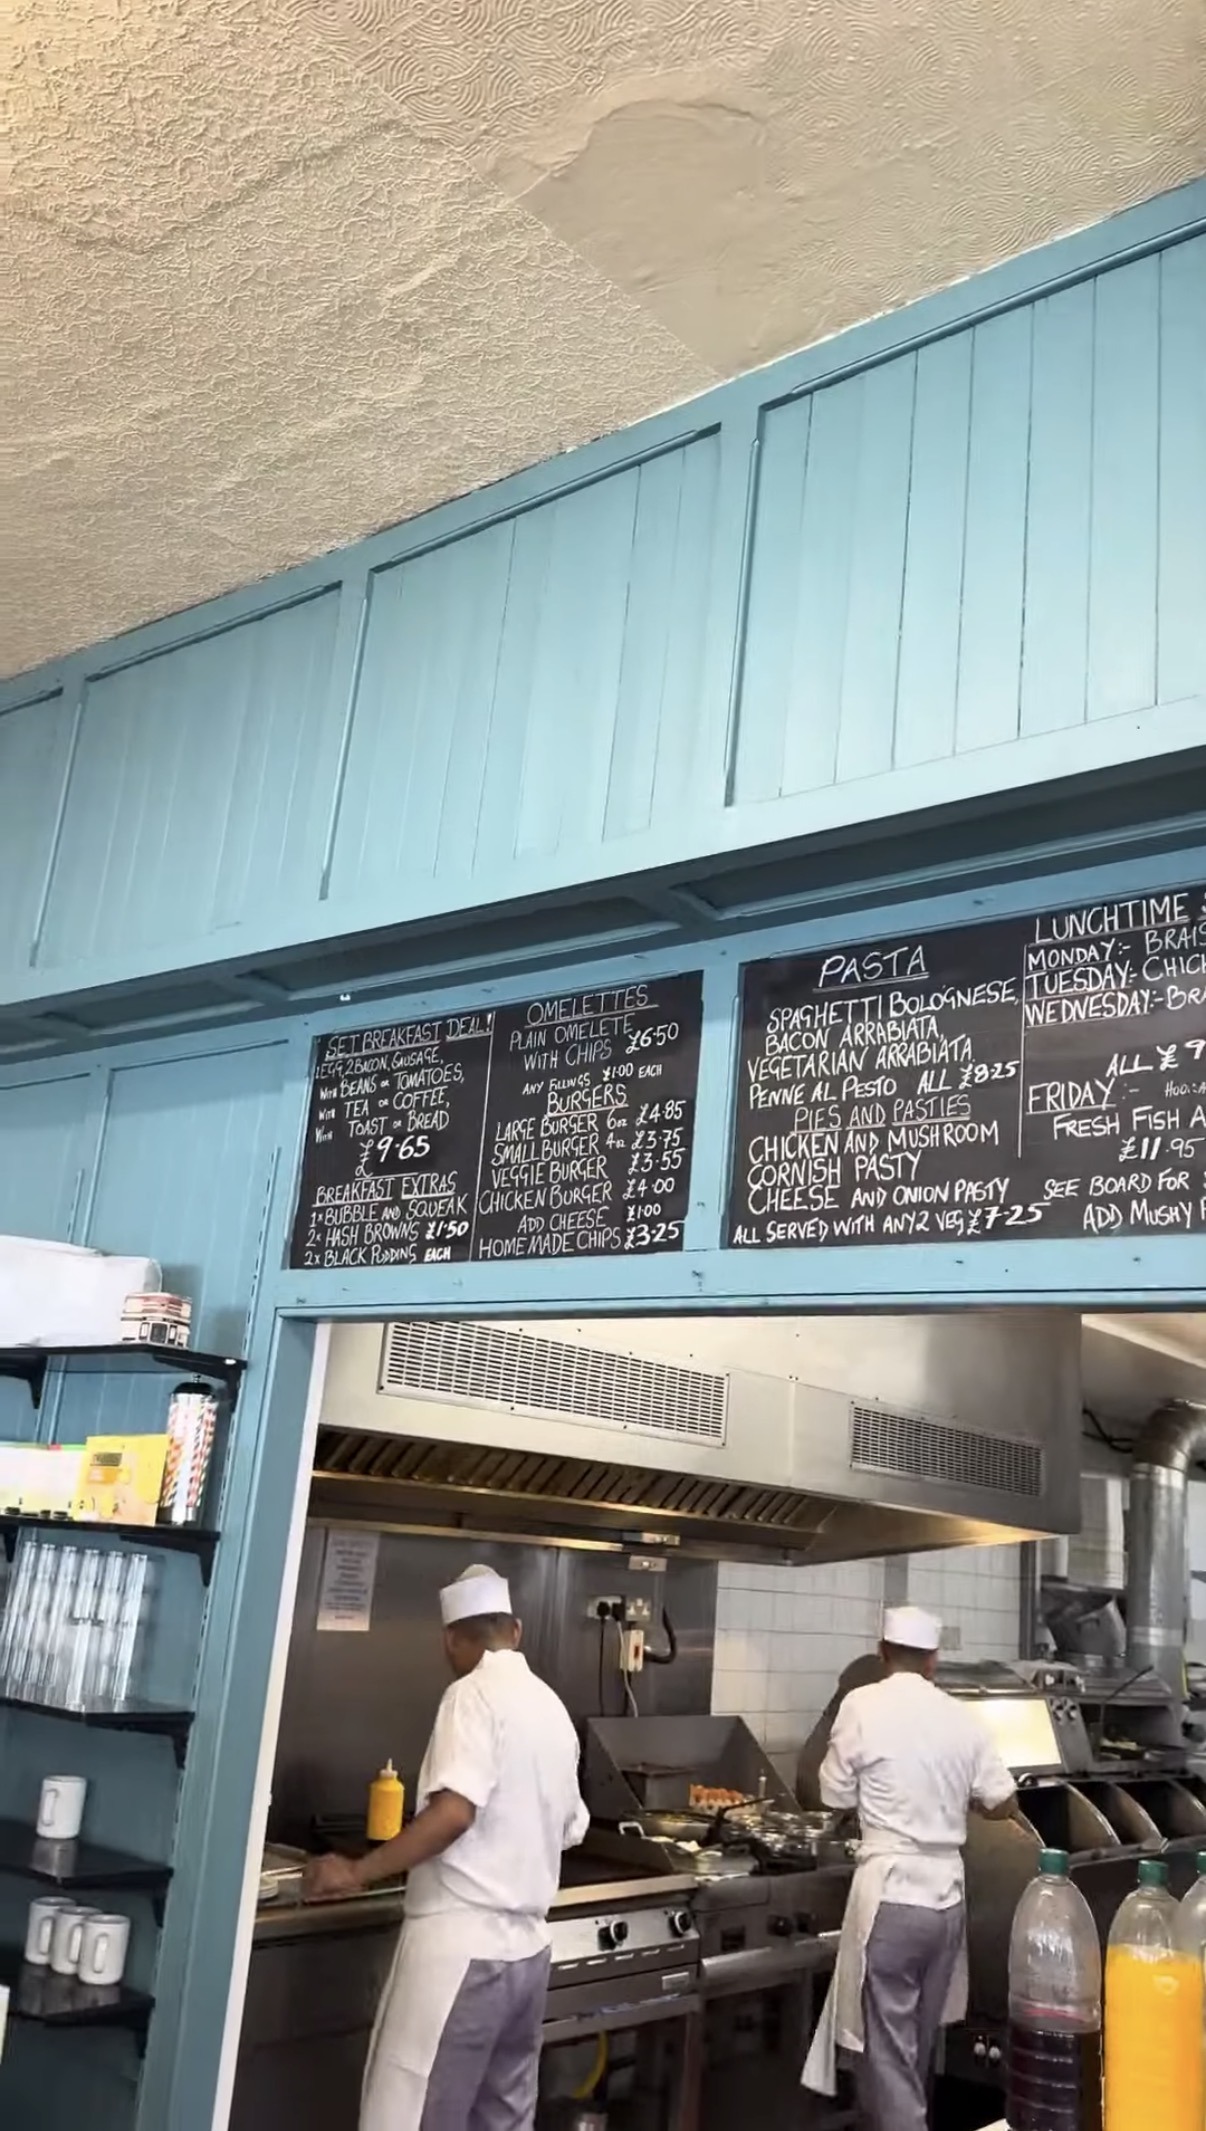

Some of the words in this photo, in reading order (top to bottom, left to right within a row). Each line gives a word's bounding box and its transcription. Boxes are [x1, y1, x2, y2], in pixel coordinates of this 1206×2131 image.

[1035, 893, 1189, 944] LUNCHTIME
[818, 945, 926, 988] PASTA
[526, 984, 648, 1026] OMELETTES
[767, 995, 882, 1034] SPAGHETTI
[889, 976, 1020, 1018] BOLOGNESE,
[326, 1034, 359, 1058] SET
[362, 1021, 442, 1052] BREAKFAST
[447, 1013, 492, 1036] DEAL!
[509, 1030, 547, 1051] PLAIN
[765, 1027, 830, 1056] BACON
[839, 1015, 945, 1049] ARRABIATA,
[392, 1046, 444, 1070] SAUSAGE,
[523, 1050, 558, 1071] WITH
[565, 1038, 612, 1066] CHIPS
[747, 1046, 869, 1083] VEGETARIAN
[1106, 1053, 1153, 1078] ALL
[340, 1074, 378, 1098] BEANS
[394, 1063, 464, 1090] TOMATOES,
[522, 1081, 544, 1095] ANY
[549, 1072, 591, 1091] FILLINGS
[638, 1064, 662, 1079] EACH
[749, 1083, 805, 1110] PENNE
[810, 1081, 837, 1103] AL
[842, 1075, 898, 1101] PESTO
[917, 1070, 953, 1095] ALL
[344, 1099, 369, 1118] TEA
[393, 1085, 450, 1110] COFFEE,
[547, 1083, 628, 1115] BURGERS
[794, 1104, 841, 1132] PIES
[849, 1103, 886, 1128] AND
[893, 1094, 971, 1122] PASTIES
[348, 1116, 389, 1138] TOAST
[407, 1109, 450, 1132] BREAD
[495, 1117, 536, 1142] LARGE
[540, 1112, 599, 1138] BURGER
[1053, 1112, 1120, 1140] FRESH
[1132, 1105, 1179, 1131] FISH
[491, 1142, 540, 1165] SMALL
[541, 1132, 600, 1161] BURGER
[749, 1131, 839, 1164] CHICKEN
[844, 1129, 880, 1155] AND
[888, 1120, 999, 1150] MUSHROOM
[491, 1162, 546, 1189] VEGGIE
[549, 1155, 609, 1184] BURGER
[747, 1157, 841, 1188] CORNISH
[855, 1149, 922, 1181] PASTY
[1043, 1178, 1081, 1200] SEE
[1089, 1172, 1152, 1197] BOARD
[1158, 1167, 1189, 1191] FOR
[316, 1178, 395, 1204] BREAKFAST
[401, 1171, 458, 1197] EXTRAS
[478, 1188, 547, 1215] CHICKEN
[550, 1180, 613, 1209] BURGER
[748, 1184, 840, 1216] CHEESE
[851, 1187, 887, 1209] AND
[892, 1181, 949, 1203] ONION
[954, 1177, 1010, 1204] PASTY
[324, 1203, 379, 1226] BUBBLE
[381, 1206, 401, 1221] AND
[406, 1193, 468, 1220] SQUEAK
[517, 1214, 545, 1234] ADD
[550, 1206, 610, 1231] CHEESE
[1083, 1202, 1123, 1235] ADD
[1130, 1198, 1192, 1229] MUSHY
[325, 1222, 359, 1247] HASH
[364, 1221, 420, 1245] BROWNS
[576, 1226, 622, 1249] CHIPS
[732, 1224, 761, 1245] ALL
[766, 1220, 828, 1243] SERVED
[832, 1215, 875, 1236] WITH
[883, 1210, 916, 1235] ANY
[916, 1211, 930, 1232] 2
[935, 1210, 964, 1236] VEG
[324, 1247, 367, 1267] BLACK
[424, 1246, 451, 1262] EACH
